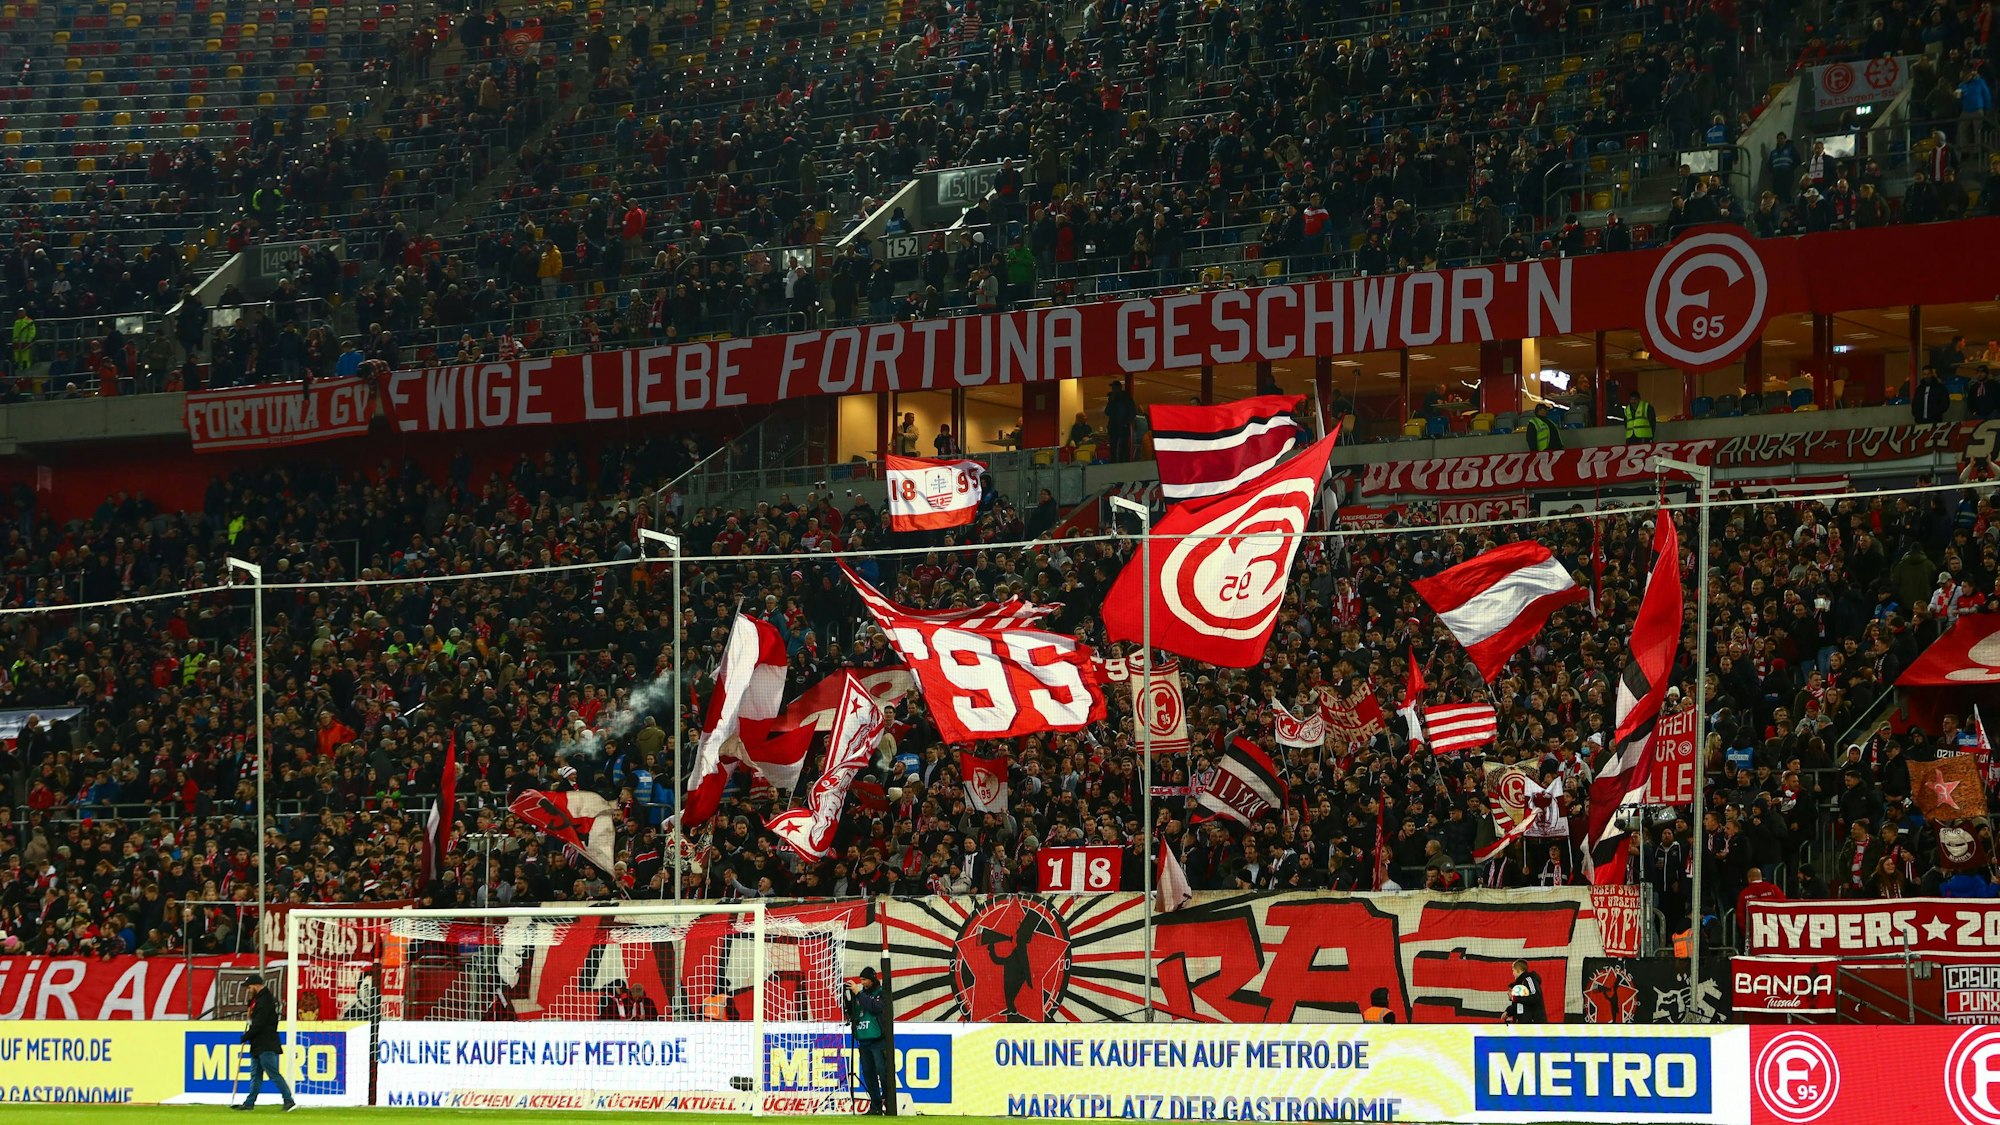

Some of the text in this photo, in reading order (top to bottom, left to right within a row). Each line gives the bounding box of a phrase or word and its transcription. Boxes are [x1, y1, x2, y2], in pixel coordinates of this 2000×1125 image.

[947, 177, 968, 198] 151
[888, 237, 917, 258] 152
[1692, 315, 1725, 340] 95
[388, 258, 1573, 431] EWIGE LIEBE FORTUNA GESCHWOR'N
[187, 392, 319, 440] FORTUNA
[1714, 421, 1958, 464] ANGRY YOUTH
[1362, 439, 1717, 492] DIVISION WEST
[891, 479, 916, 501] 18
[957, 467, 979, 494] 95
[1319, 681, 1372, 711] ORTUNA
[1328, 708, 1362, 728] PER
[1658, 707, 1695, 737] IHEIT
[1655, 739, 1676, 763] ÜR
[981, 789, 991, 800] 95
[1645, 762, 1693, 803] LLE
[1618, 884, 1640, 896] STOL
[1752, 911, 1918, 949] HYPERS
[297, 966, 332, 989] TRAS
[1735, 973, 1832, 995] BANDA
[27, 1038, 112, 1062] METRO.DE
[193, 1044, 337, 1082] MEO
[379, 1037, 687, 1066] ONLINE KAUFEN AUF METRO.DE
[995, 1039, 1369, 1069] ONLINE KAUFEN AUF METRO.DE
[1488, 1052, 1698, 1098] METRO
[452, 1090, 582, 1108] KÜCHEN AKTUELL
[596, 1094, 736, 1111] KÜCHEN AKTUELL
[761, 1096, 870, 1114] ÜCHEN AKTU
[1797, 1084, 1818, 1101] 95
[1008, 1093, 1402, 1125] MARKTPLATZ DER GASTRONOMIE
